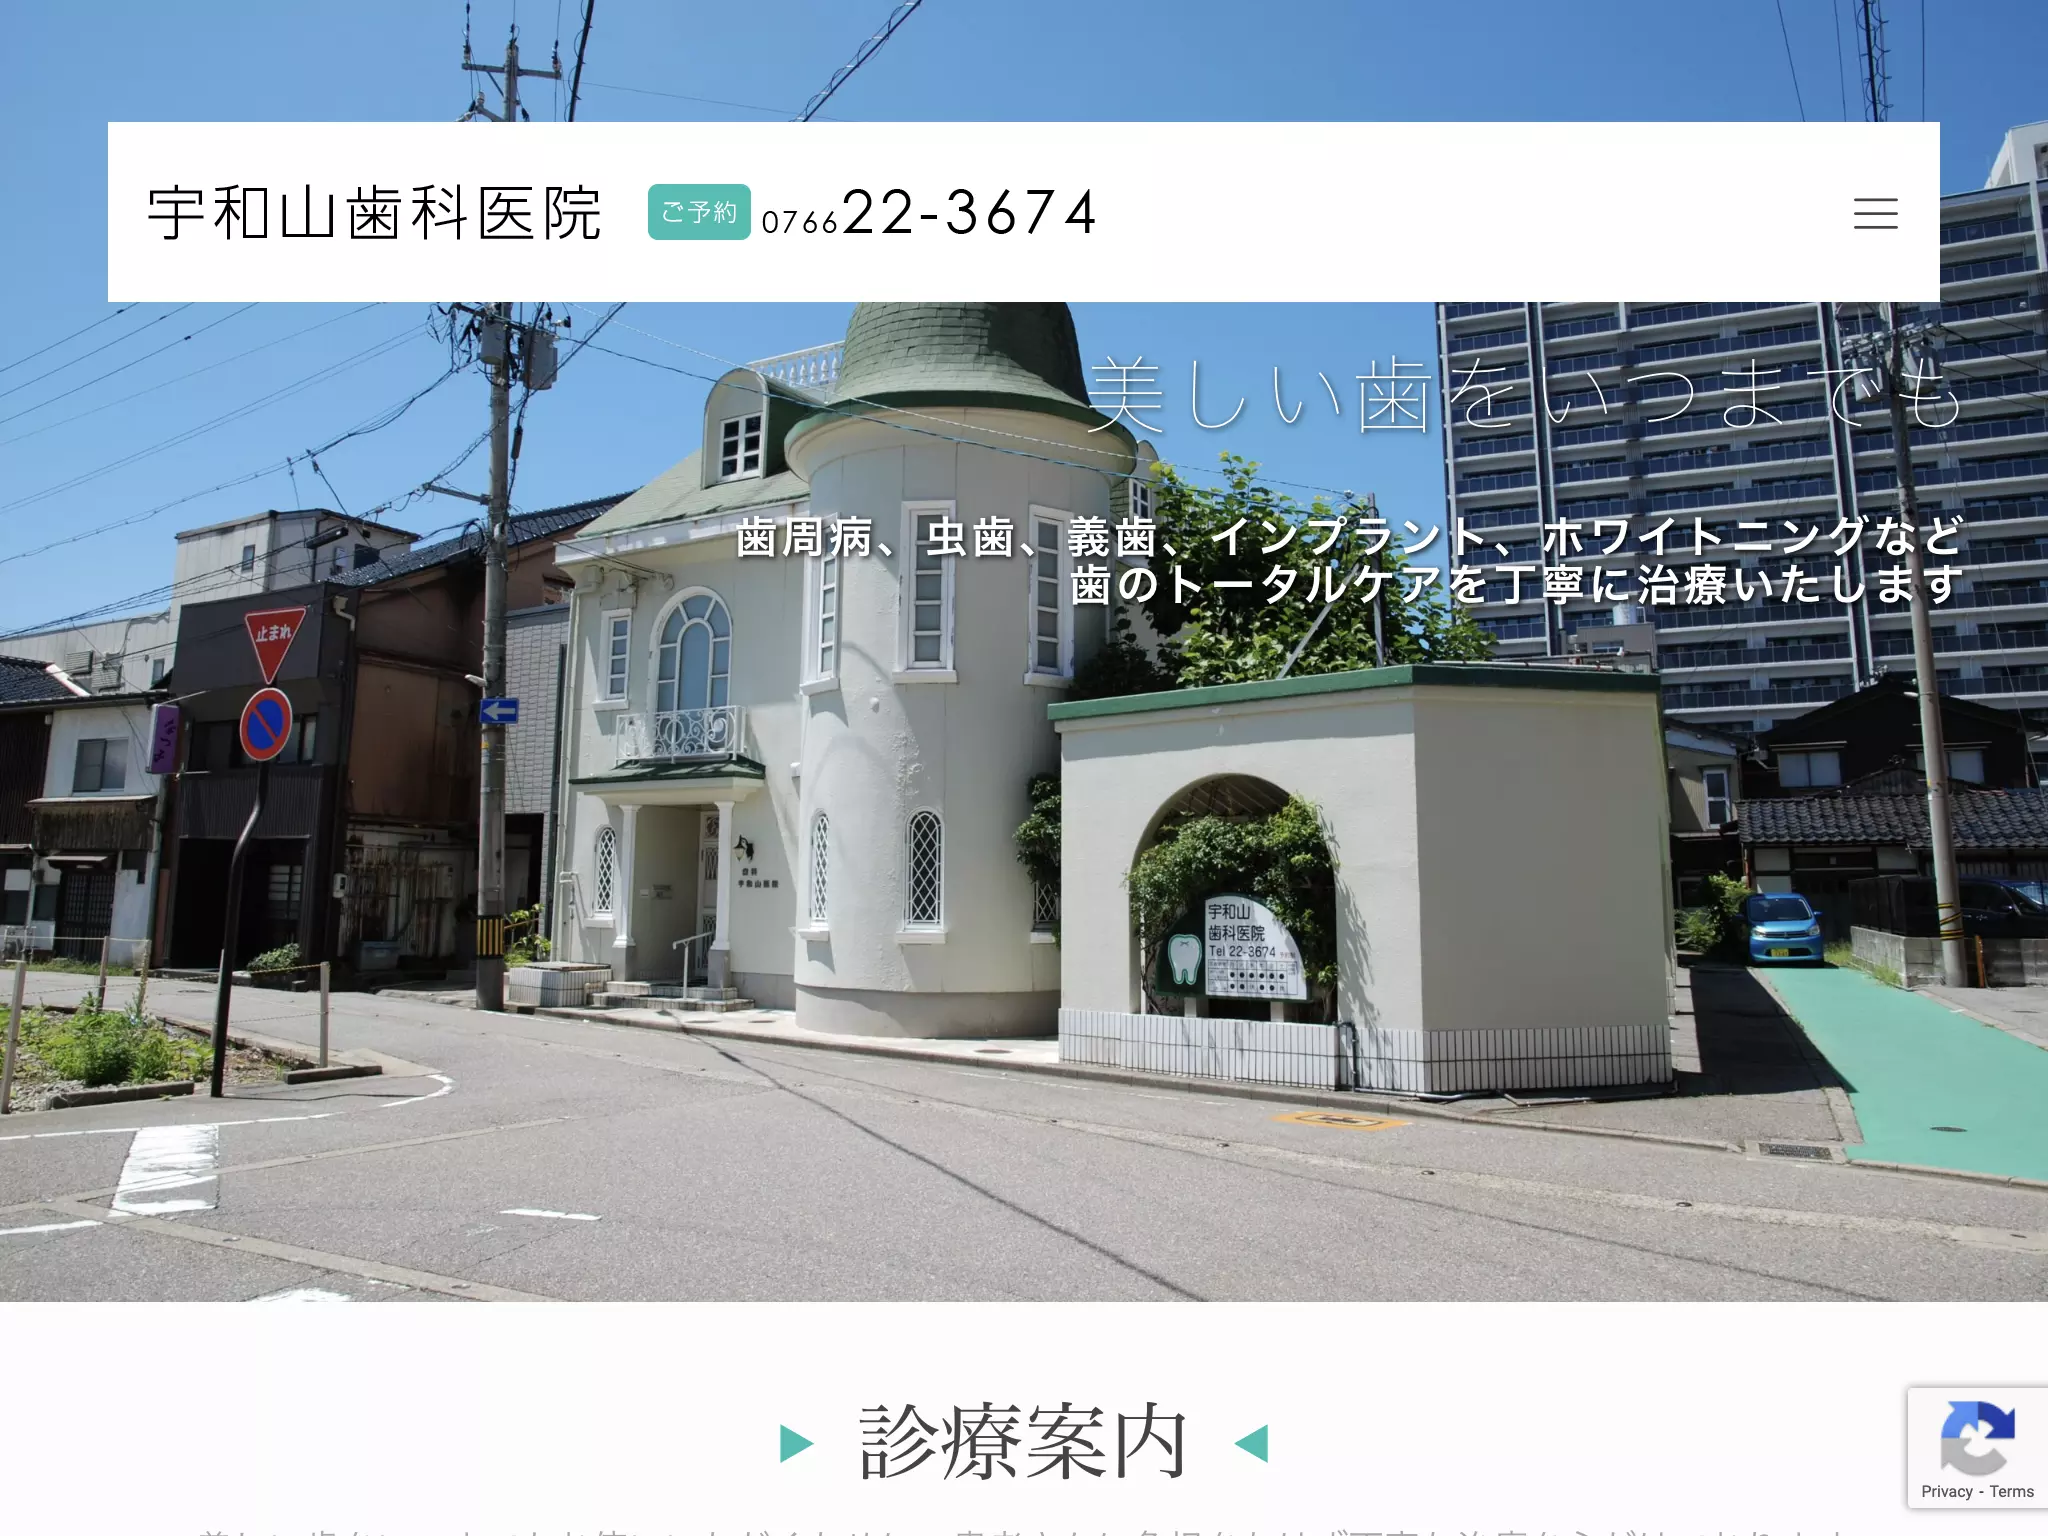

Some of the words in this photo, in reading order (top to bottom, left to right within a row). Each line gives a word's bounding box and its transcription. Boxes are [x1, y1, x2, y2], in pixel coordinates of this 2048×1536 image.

[255, 623, 292, 643] 止まれ
[1208, 903, 1251, 920] 宇和山
[1208, 924, 1265, 942] 歯科医院
[1209, 945, 1226, 957] Tel
[1229, 945, 1276, 958] 22-3674
